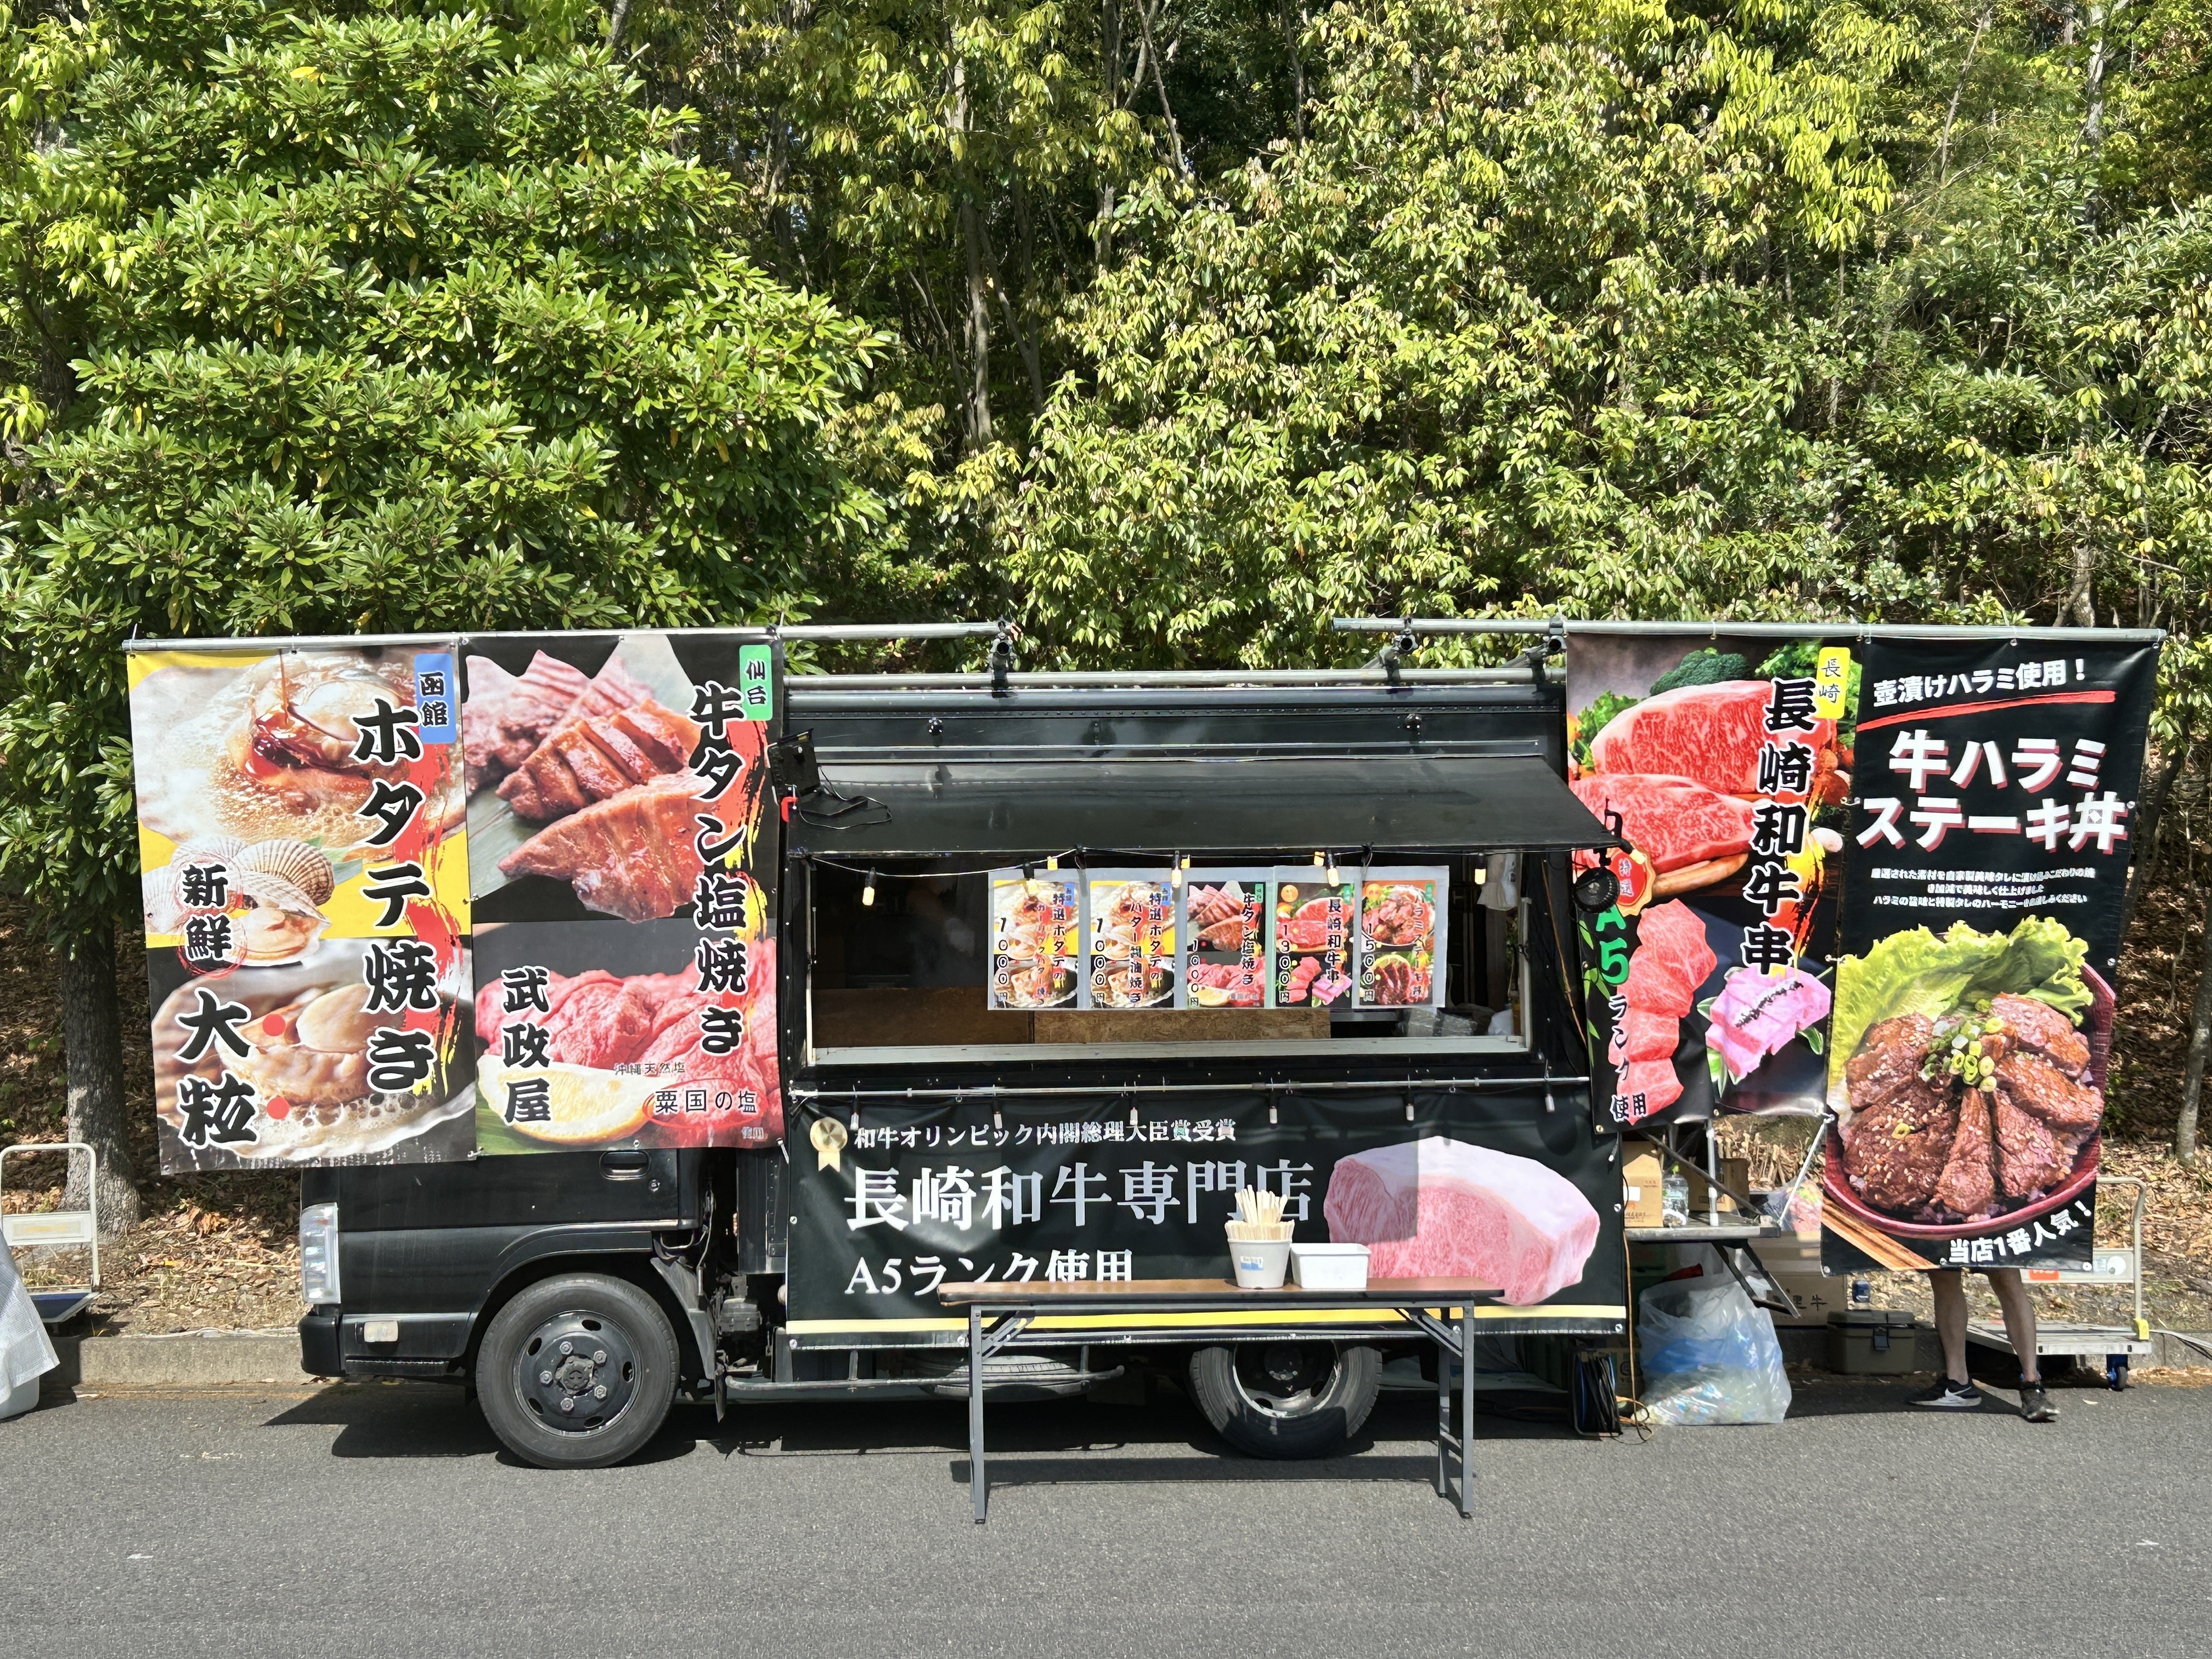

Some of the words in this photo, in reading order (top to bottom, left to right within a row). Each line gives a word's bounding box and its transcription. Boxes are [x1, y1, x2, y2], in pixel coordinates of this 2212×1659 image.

[421, 672, 449, 726] 函館
[746, 660, 766, 705] 仙台
[1820, 660, 1841, 702] 長崎
[1889, 730, 2107, 793] 牛ハラミ
[1743, 680, 1817, 974] 長崎和牛串
[1856, 792, 2128, 853] ステーキ丼
[351, 699, 438, 1092] ホタテ焼き
[690, 683, 748, 1053] 牛タン塩焼き
[182, 865, 232, 961] 新鮮
[174, 989, 259, 1143] 大粒
[503, 968, 550, 1122] 武政屋
[655, 1090, 757, 1113] 粟国の塩
[854, 1119, 1236, 1150] 和牛オリンピック内閣総理大臣賞受賞
[844, 1159, 1314, 1231] 長崎和牛専門店
[844, 1249, 1132, 1296] A5ランク使用
